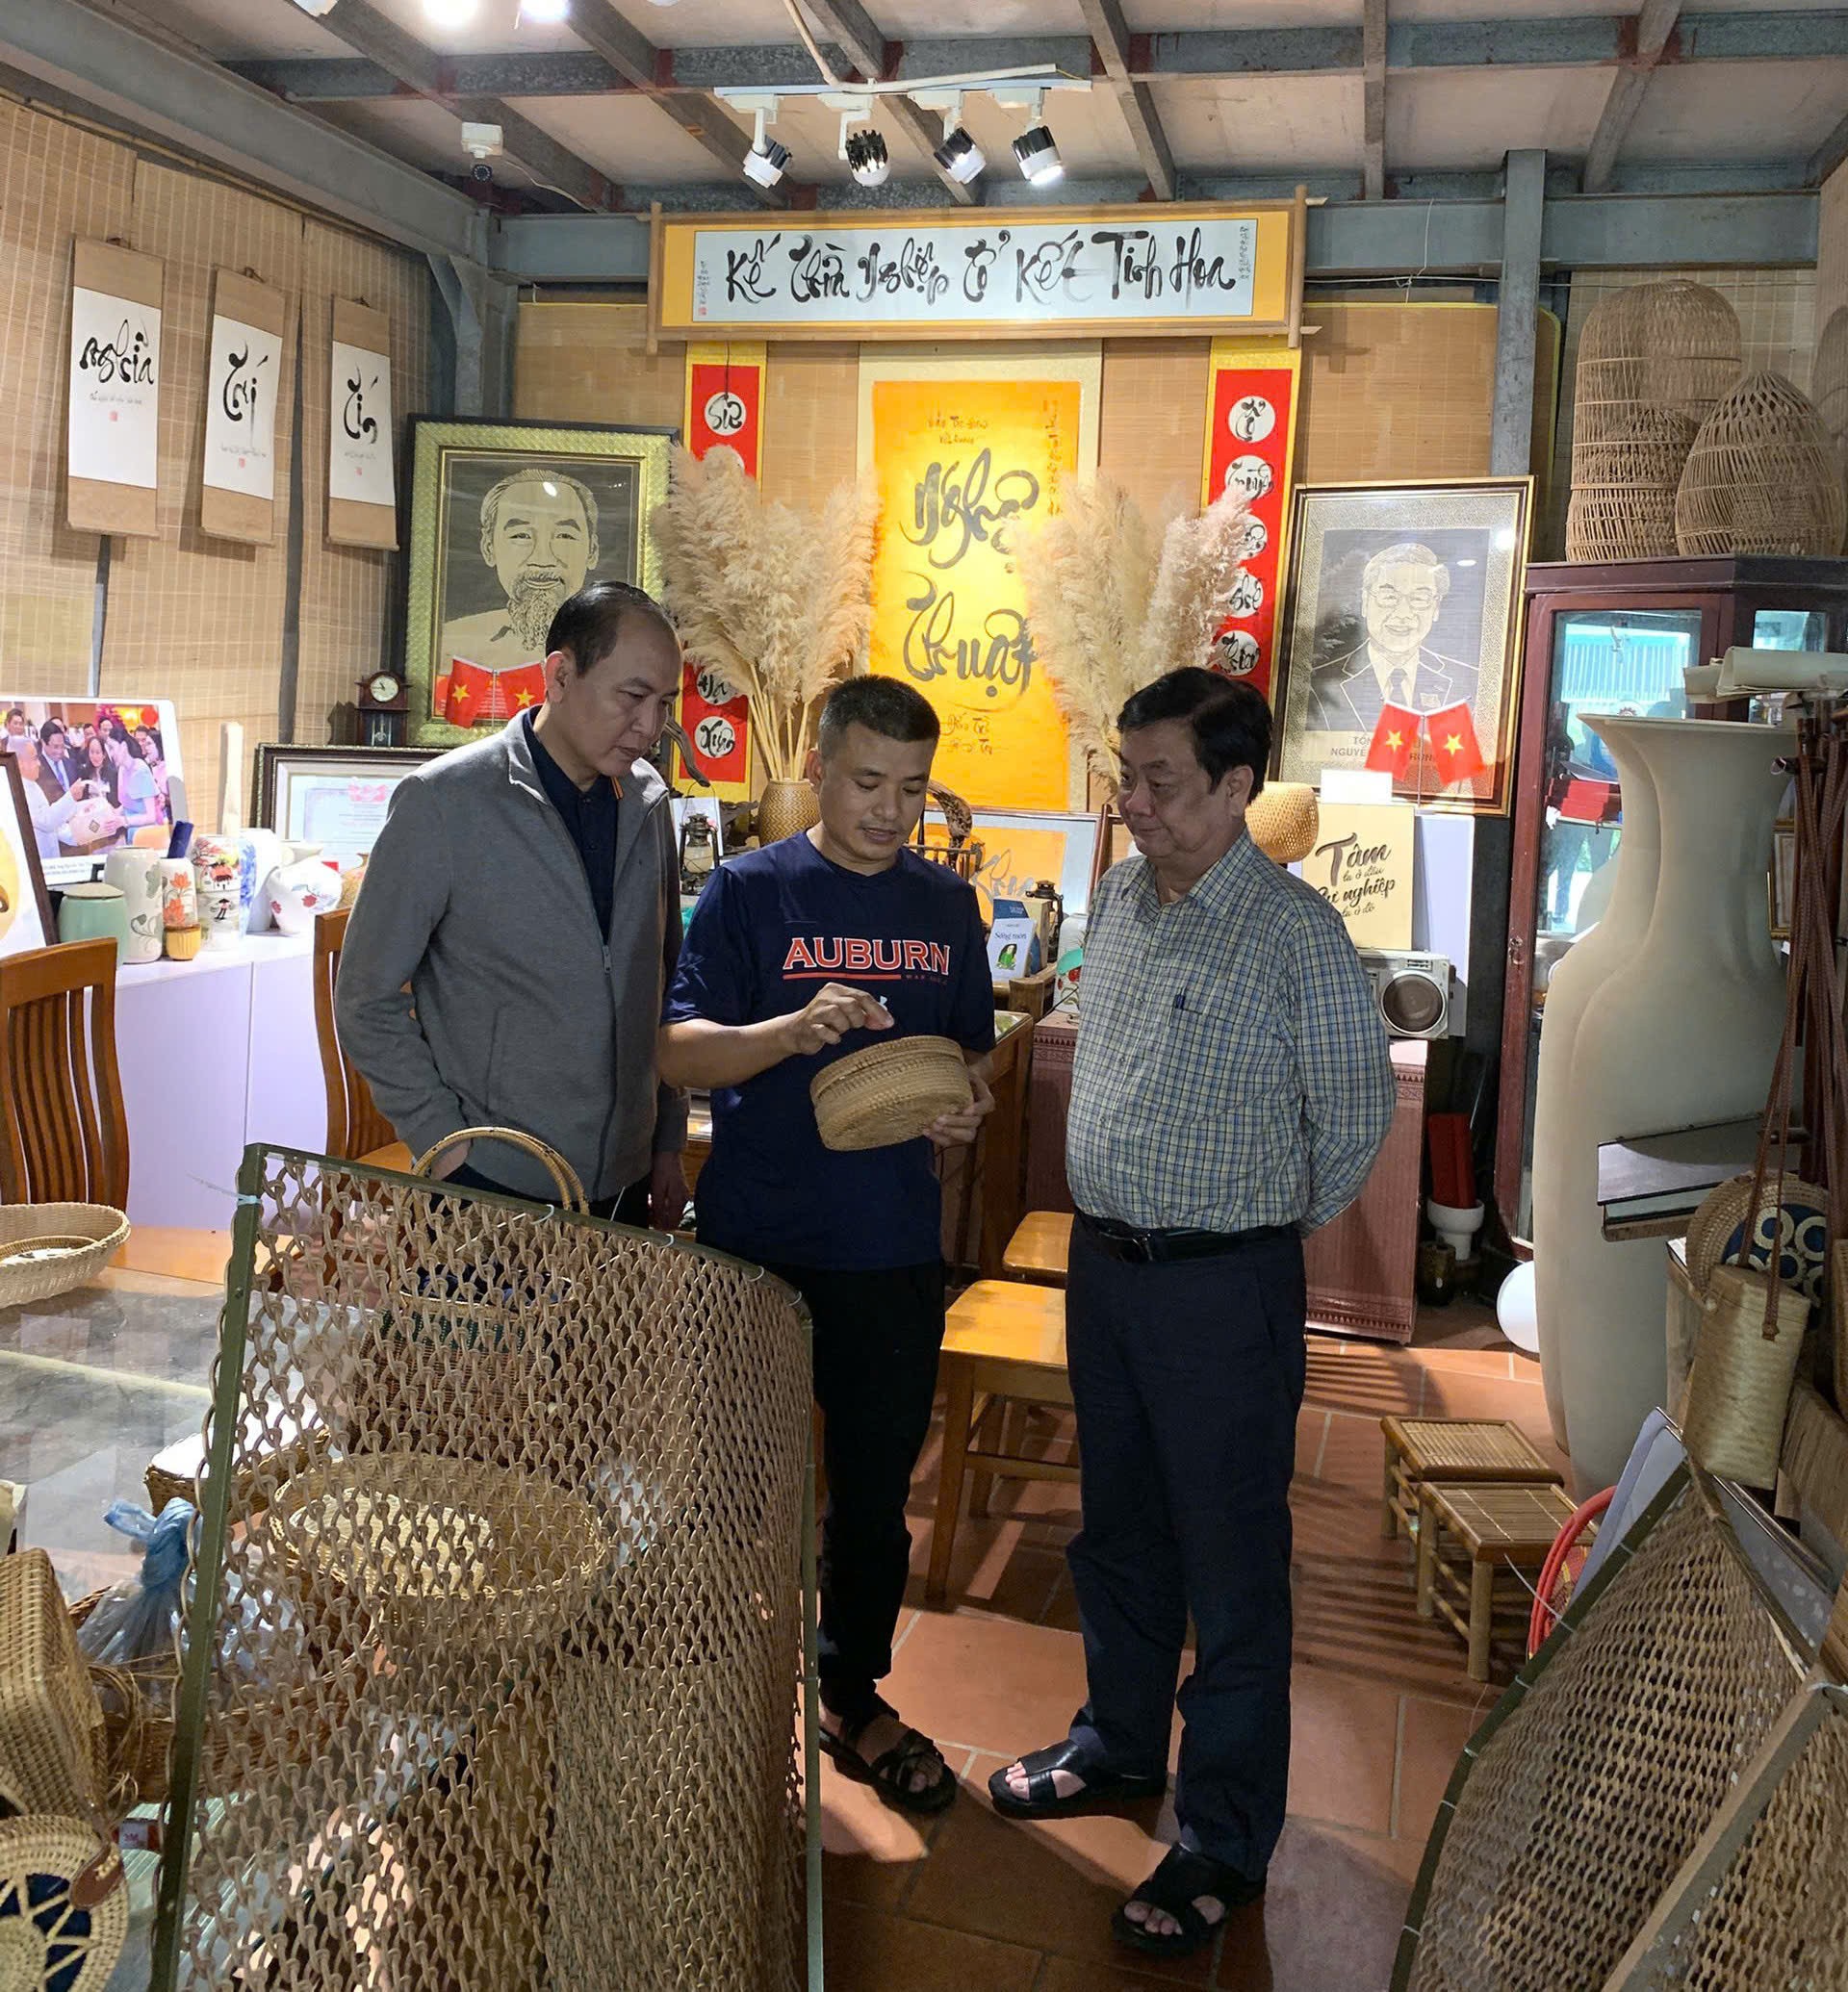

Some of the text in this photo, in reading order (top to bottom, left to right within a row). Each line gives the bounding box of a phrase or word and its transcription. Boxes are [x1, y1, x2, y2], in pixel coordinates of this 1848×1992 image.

[726, 233, 781, 303] Kế
[1315, 832, 1392, 886] Tâm
[1343, 878, 1396, 907] nghiệp
[783, 937, 950, 975] AUBURN
